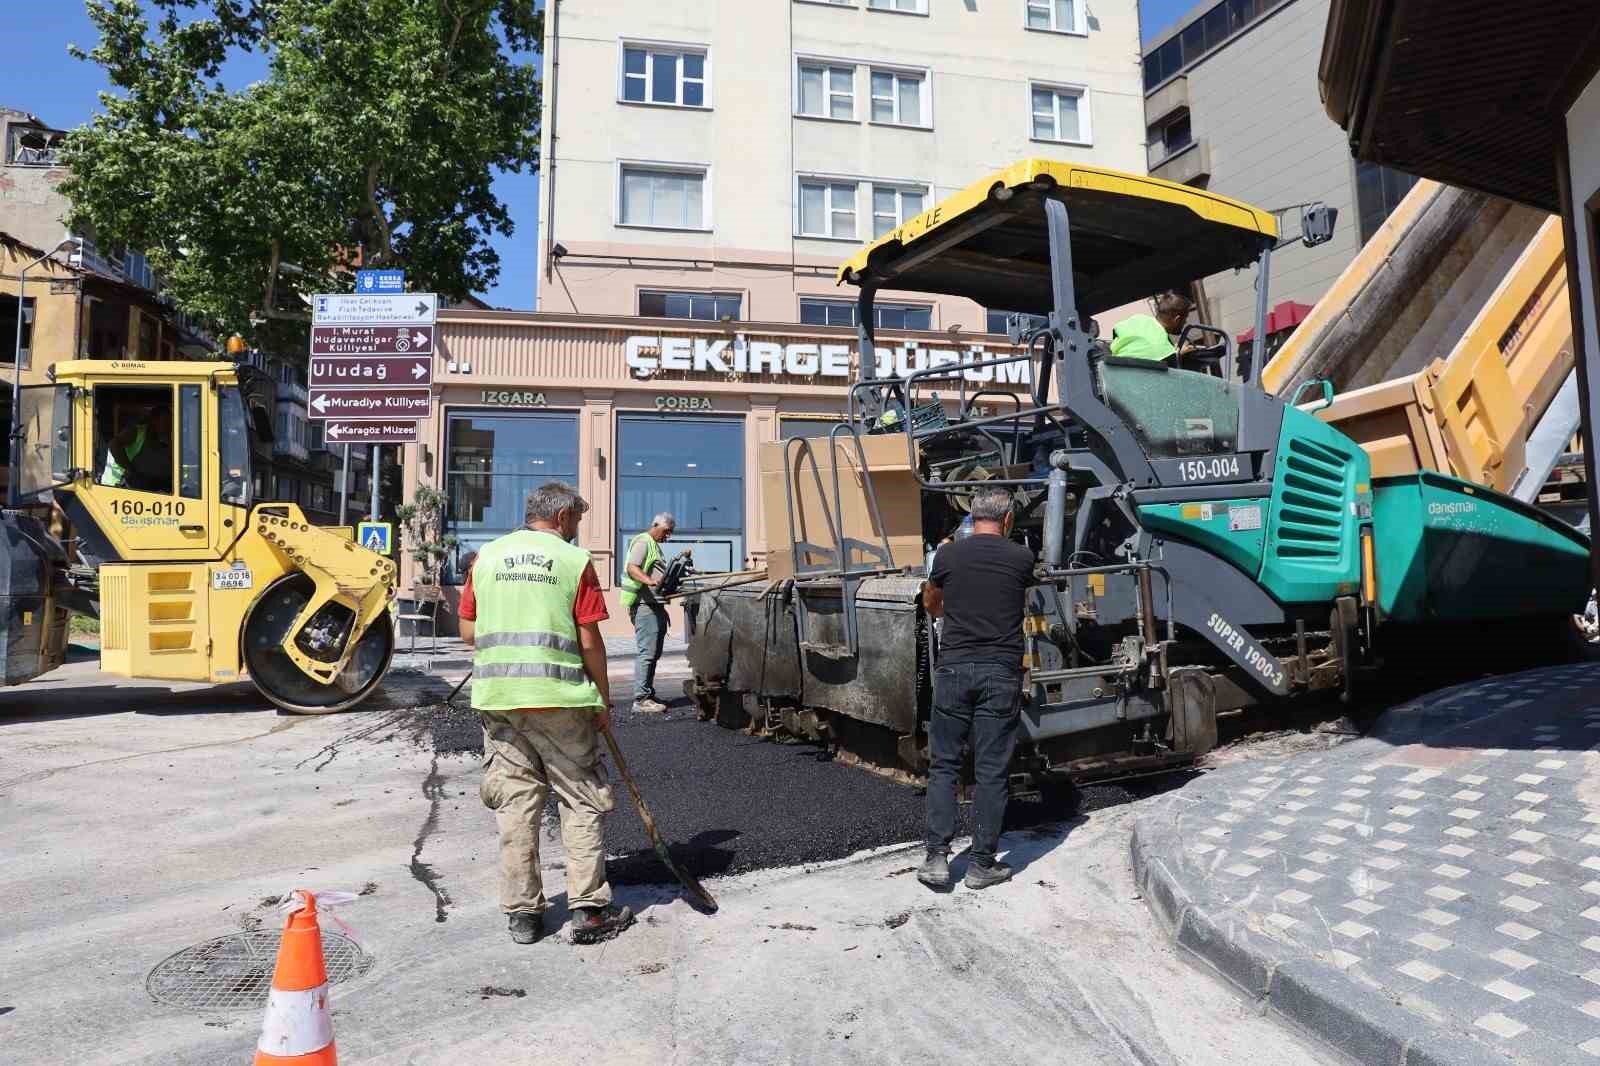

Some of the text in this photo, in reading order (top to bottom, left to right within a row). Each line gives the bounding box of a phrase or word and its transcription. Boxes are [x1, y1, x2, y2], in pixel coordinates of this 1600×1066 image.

[342, 327, 375, 335] Murat
[625, 333, 849, 378] ÇEKİRGE
[313, 363, 387, 379] Uludağ
[331, 396, 429, 409] Muradiye Külliyesi
[341, 425, 417, 436] Karagöz Müzesi
[1178, 457, 1240, 482] 150-004
[110, 499, 186, 516] 160-010
[504, 553, 553, 571] BURSA
[1207, 613, 1283, 686] SUPER 1900-3
